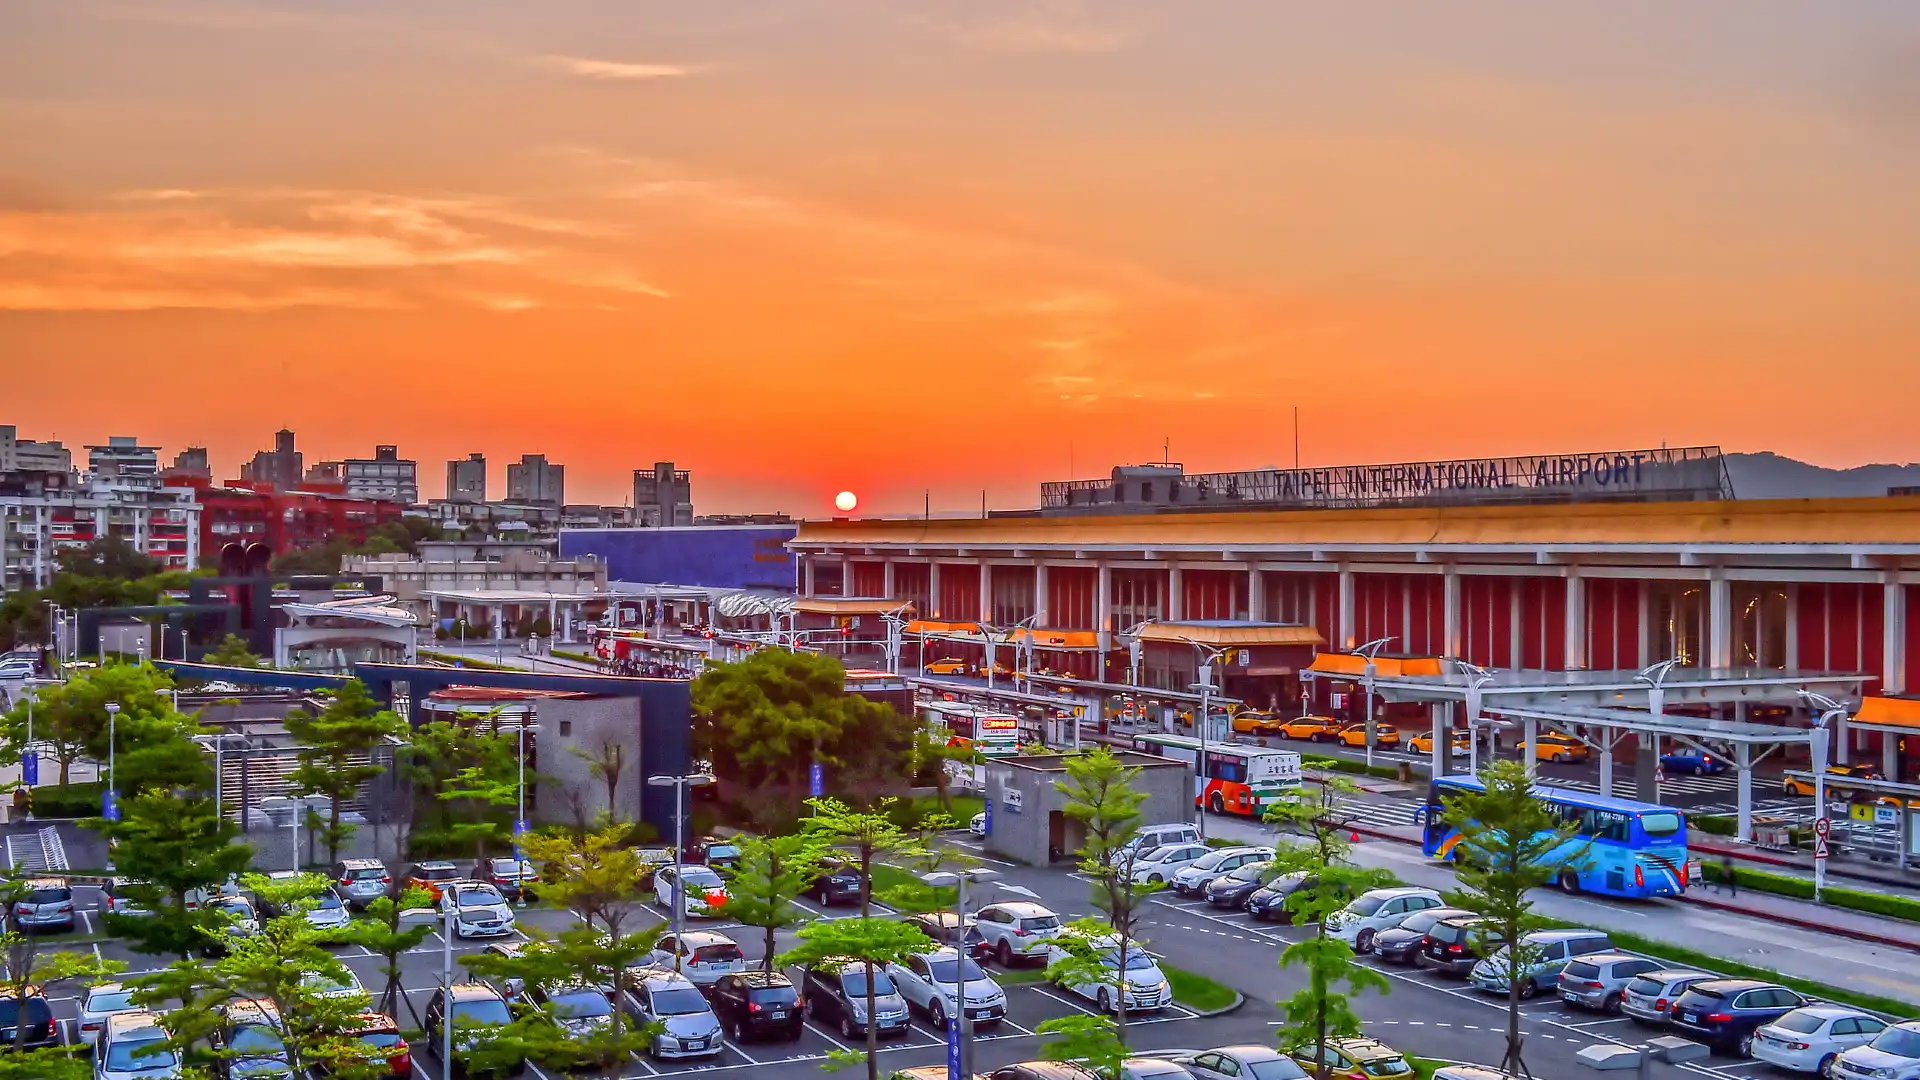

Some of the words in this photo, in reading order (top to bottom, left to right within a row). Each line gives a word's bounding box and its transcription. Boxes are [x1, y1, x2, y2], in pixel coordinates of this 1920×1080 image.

[1274, 470, 1330, 496] TAIPEI
[1348, 460, 1513, 493] INTERNATIONAL
[1535, 455, 1646, 487] AIRPORT
[1858, 808, 1865, 817] 4
[1819, 823, 1827, 831] 30
